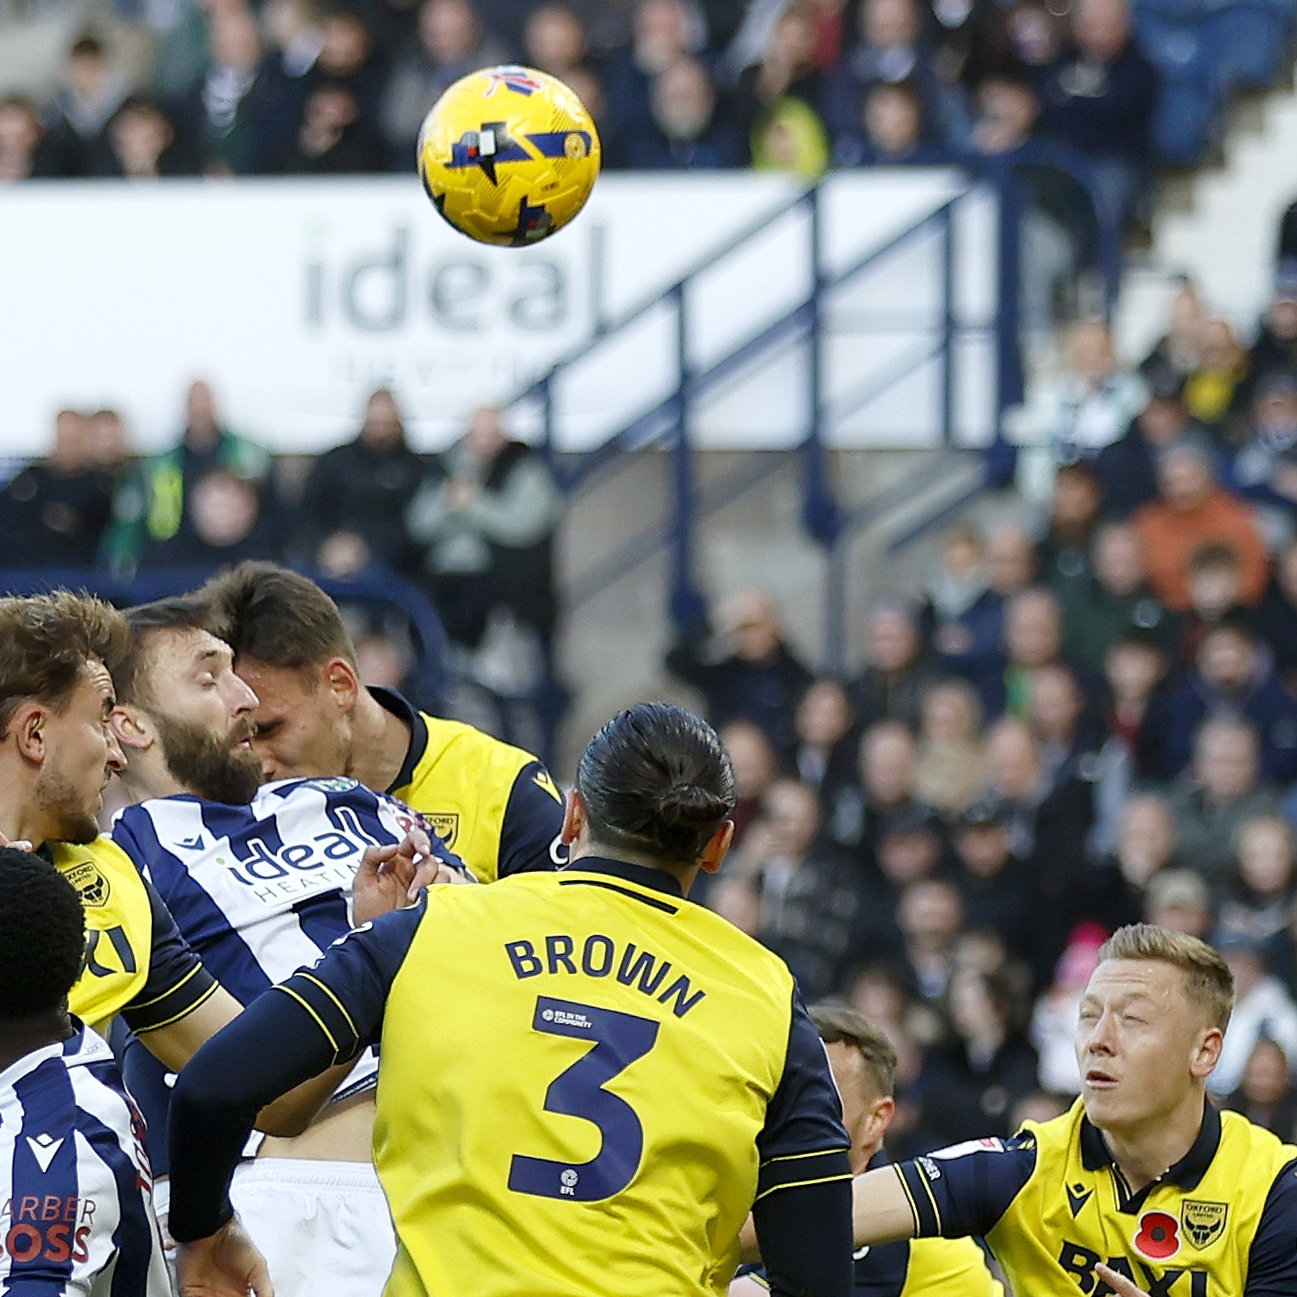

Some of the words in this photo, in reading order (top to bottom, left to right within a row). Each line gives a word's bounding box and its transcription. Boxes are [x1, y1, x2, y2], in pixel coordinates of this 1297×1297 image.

[304, 215, 608, 334] ideal
[214, 809, 377, 887] ideal
[504, 934, 707, 1018] BROWN
[507, 994, 660, 1203] 3
[560, 1185, 575, 1196] EFL
[1185, 1203, 1223, 1214] OXFORD
